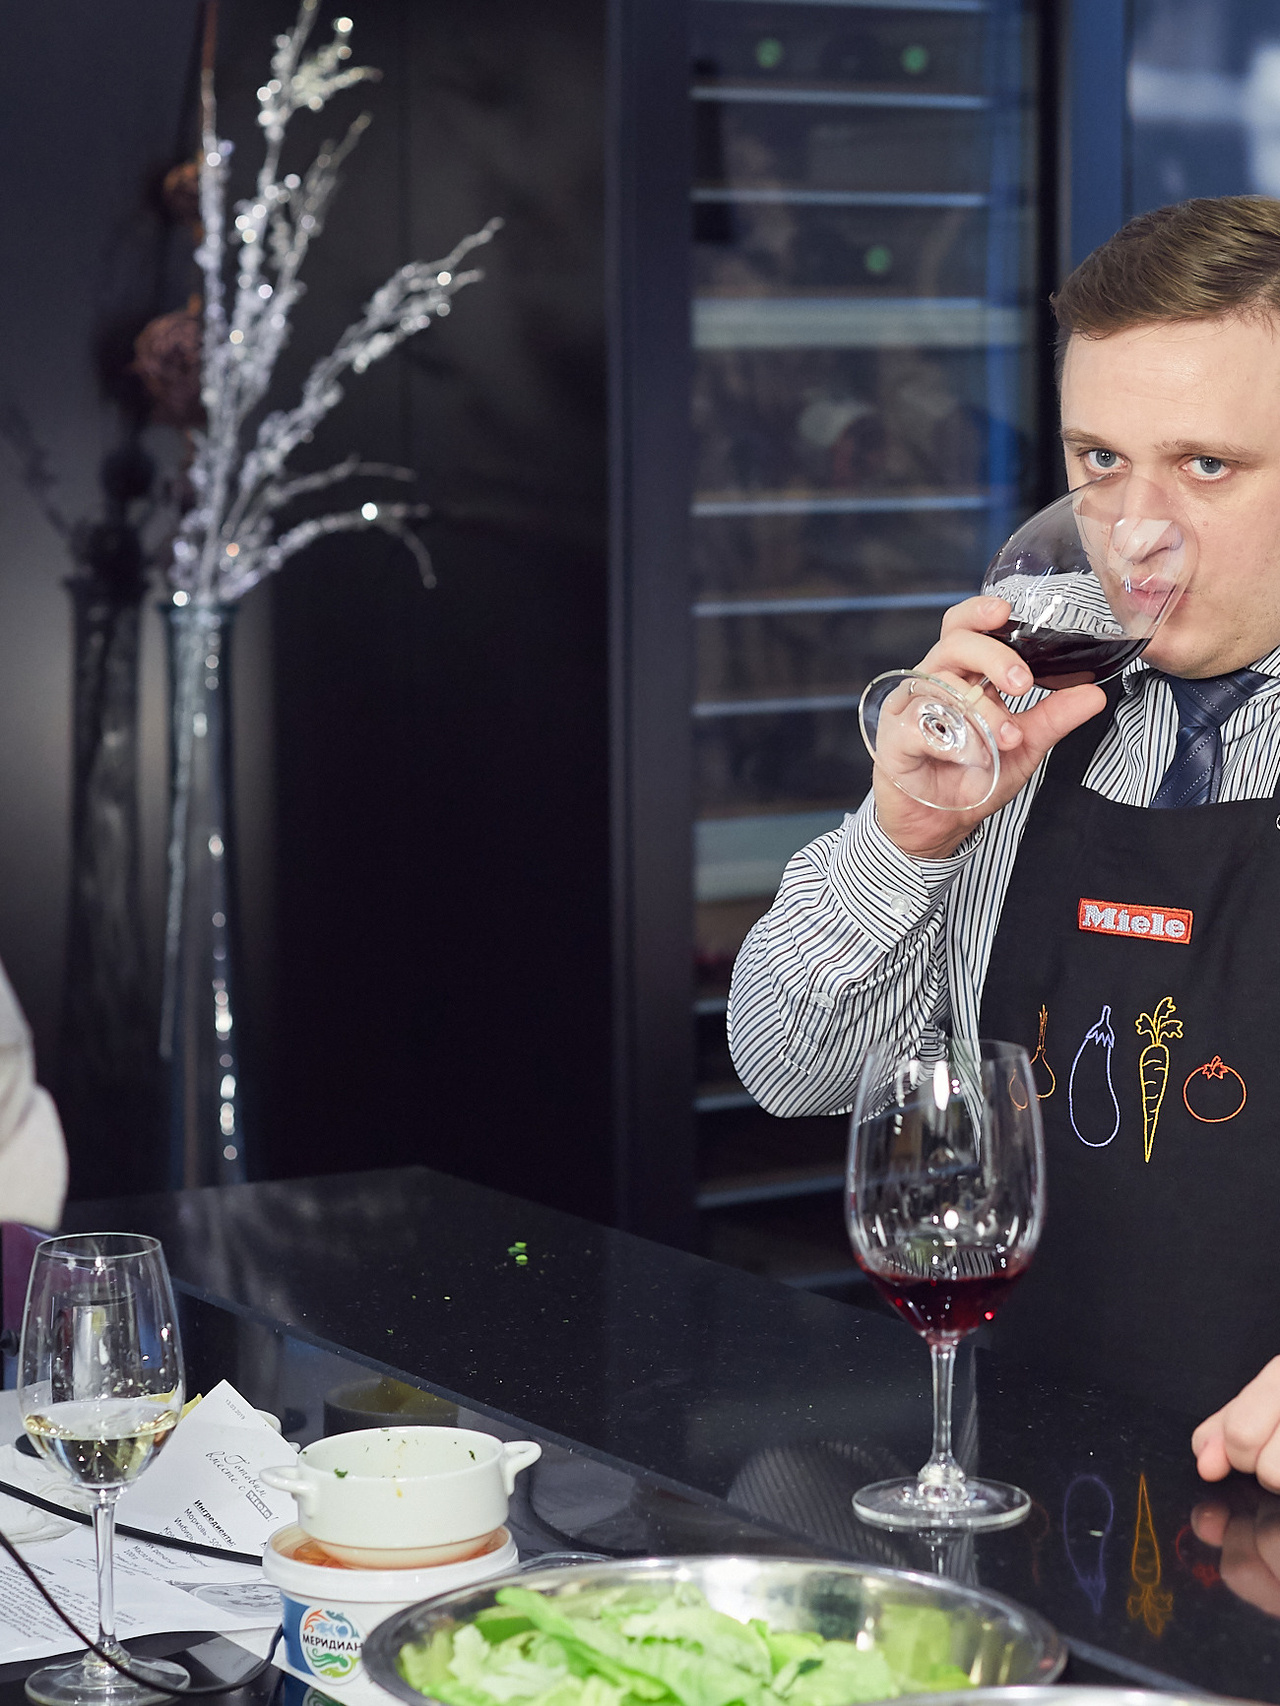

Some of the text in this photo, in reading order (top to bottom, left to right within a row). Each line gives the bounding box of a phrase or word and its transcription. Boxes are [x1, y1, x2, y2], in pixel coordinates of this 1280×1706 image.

[1082, 904, 1186, 938] Miele
[205, 1451, 238, 1485] вместе
[223, 1454, 267, 1498] Готовим
[174, 1517, 194, 1542] Имбирь
[184, 1508, 207, 1537] Морковь
[194, 1499, 236, 1548] Ингредиенты:
